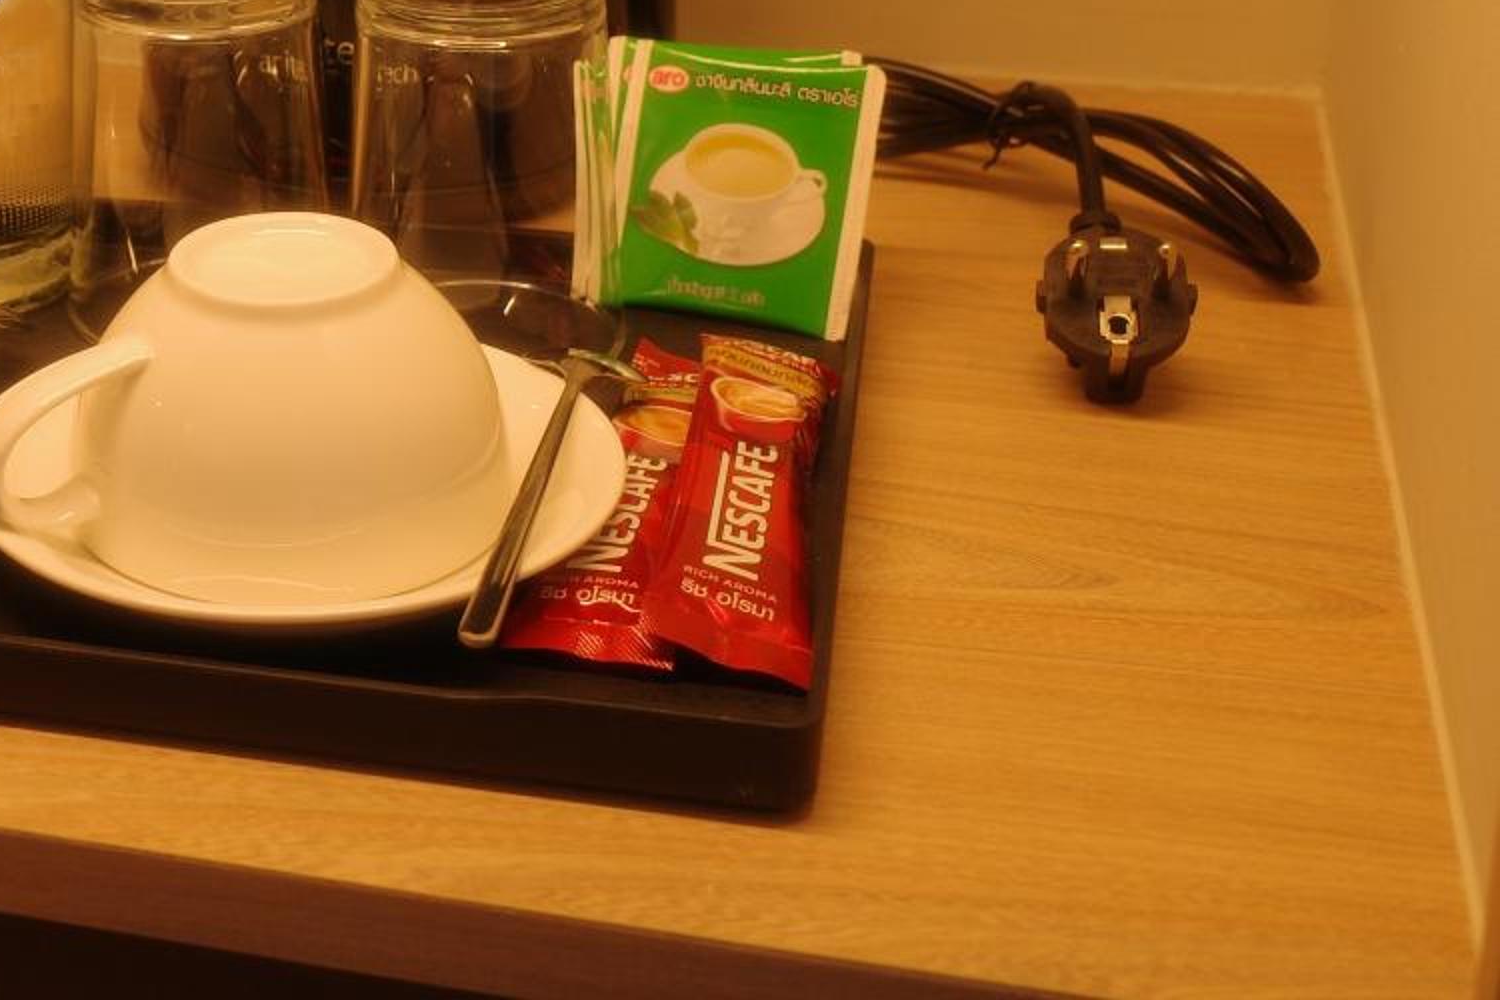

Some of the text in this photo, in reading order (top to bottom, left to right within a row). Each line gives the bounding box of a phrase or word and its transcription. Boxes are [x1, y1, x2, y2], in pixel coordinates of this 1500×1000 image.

[651, 68, 687, 86] aro
[683, 565, 778, 604] RICH AROMA
